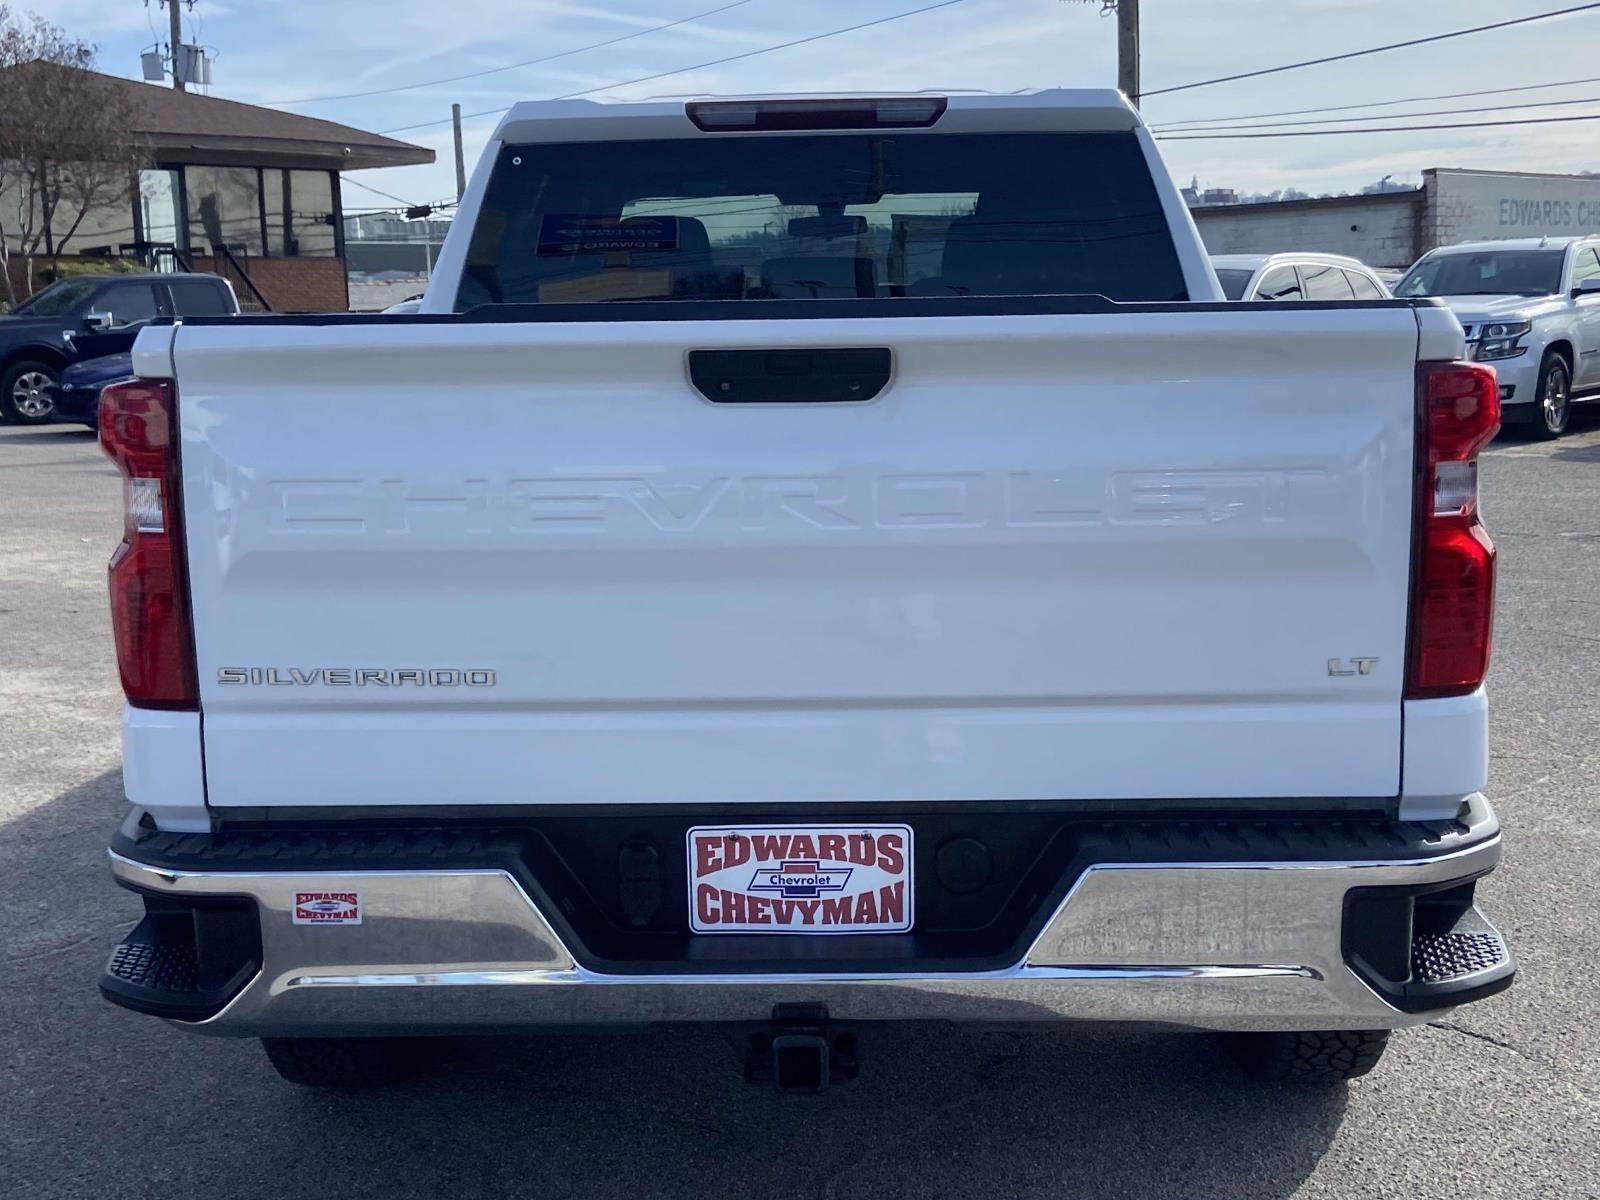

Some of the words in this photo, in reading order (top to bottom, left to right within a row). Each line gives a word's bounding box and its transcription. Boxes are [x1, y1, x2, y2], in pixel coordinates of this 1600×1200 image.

[1499, 199, 1571, 226] EDWARDS
[268, 467, 1333, 536] CHEVROLET
[1327, 656, 1380, 676] LT
[217, 667, 497, 686] SILVERADO
[695, 833, 905, 878] EDWARDS
[769, 874, 831, 886] Chevrolet
[295, 893, 358, 905] EDWARDS
[696, 880, 905, 925] CHEVYMAN
[295, 907, 358, 919] CHEVYMAN
